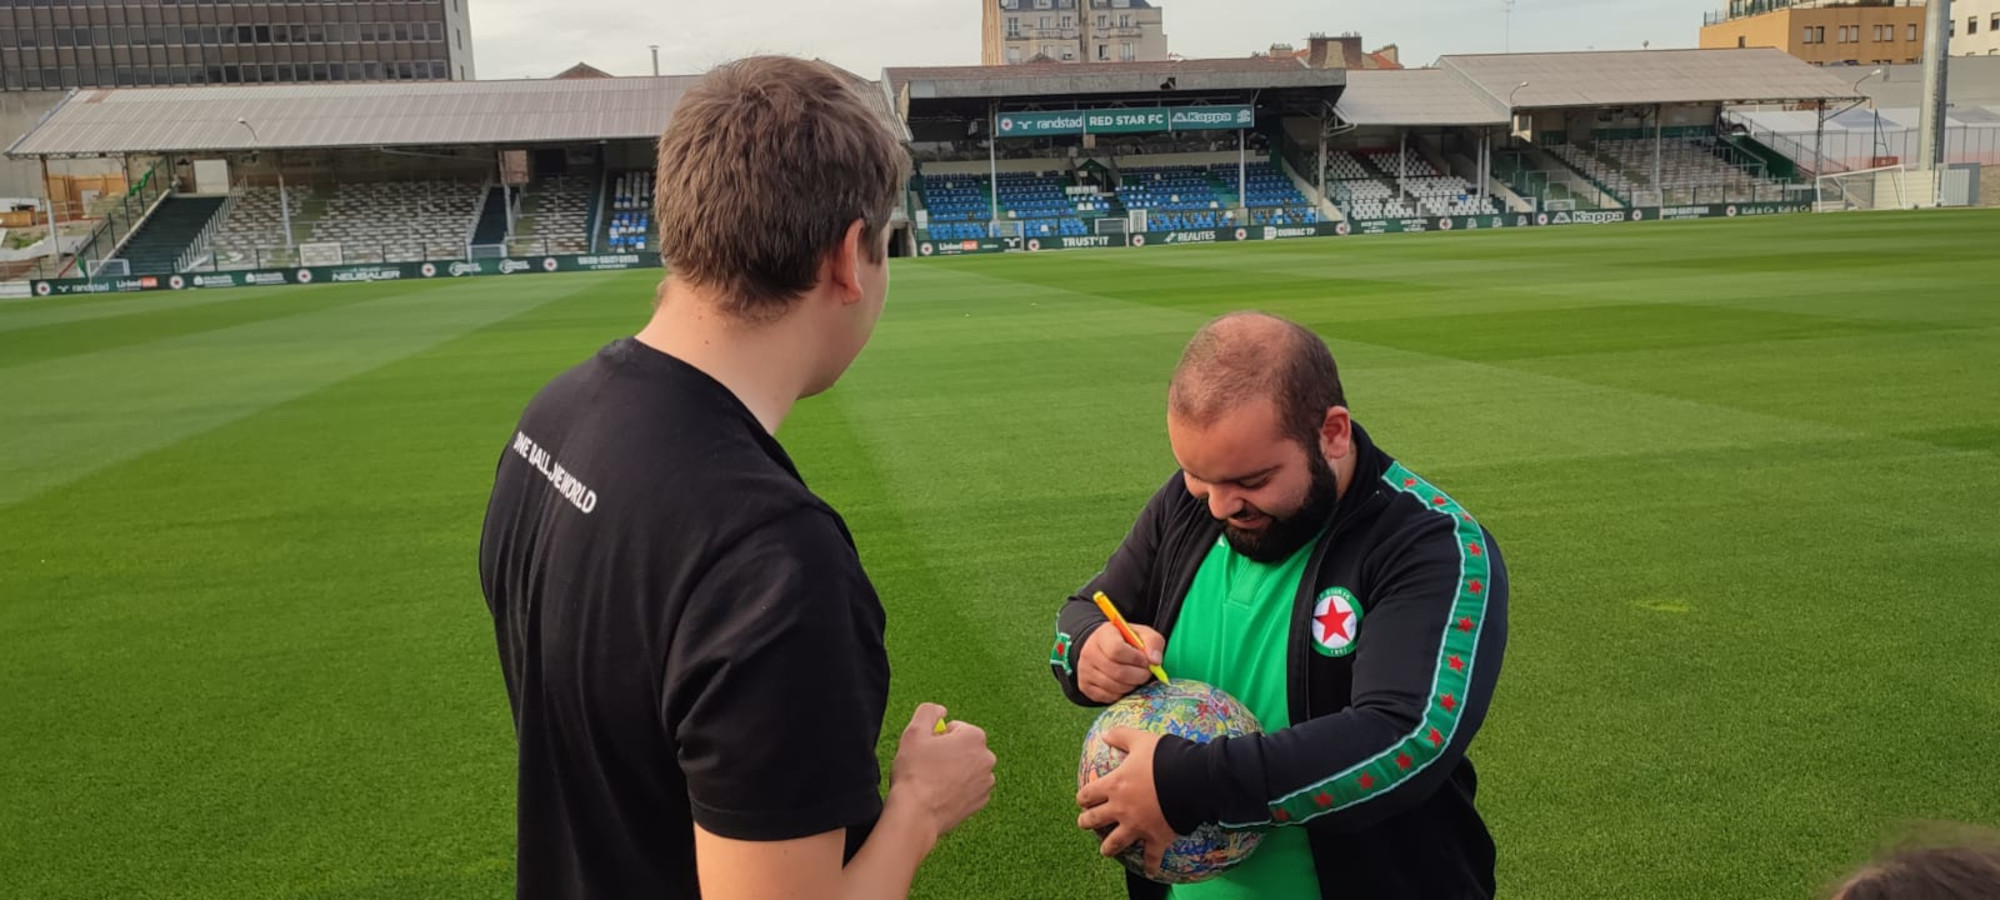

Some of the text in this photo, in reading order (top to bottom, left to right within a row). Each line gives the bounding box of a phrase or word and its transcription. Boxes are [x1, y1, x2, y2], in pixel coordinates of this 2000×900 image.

[1036, 116, 1082, 130] randstad
[1089, 114, 1164, 127] RED STAR FC
[1187, 111, 1232, 124] Kappa
[1572, 210, 1625, 224] Kappa
[332, 269, 401, 282] NEUBAUER
[72, 282, 110, 293] randstad
[513, 430, 533, 459] NE
[559, 471, 598, 514] WORLD
